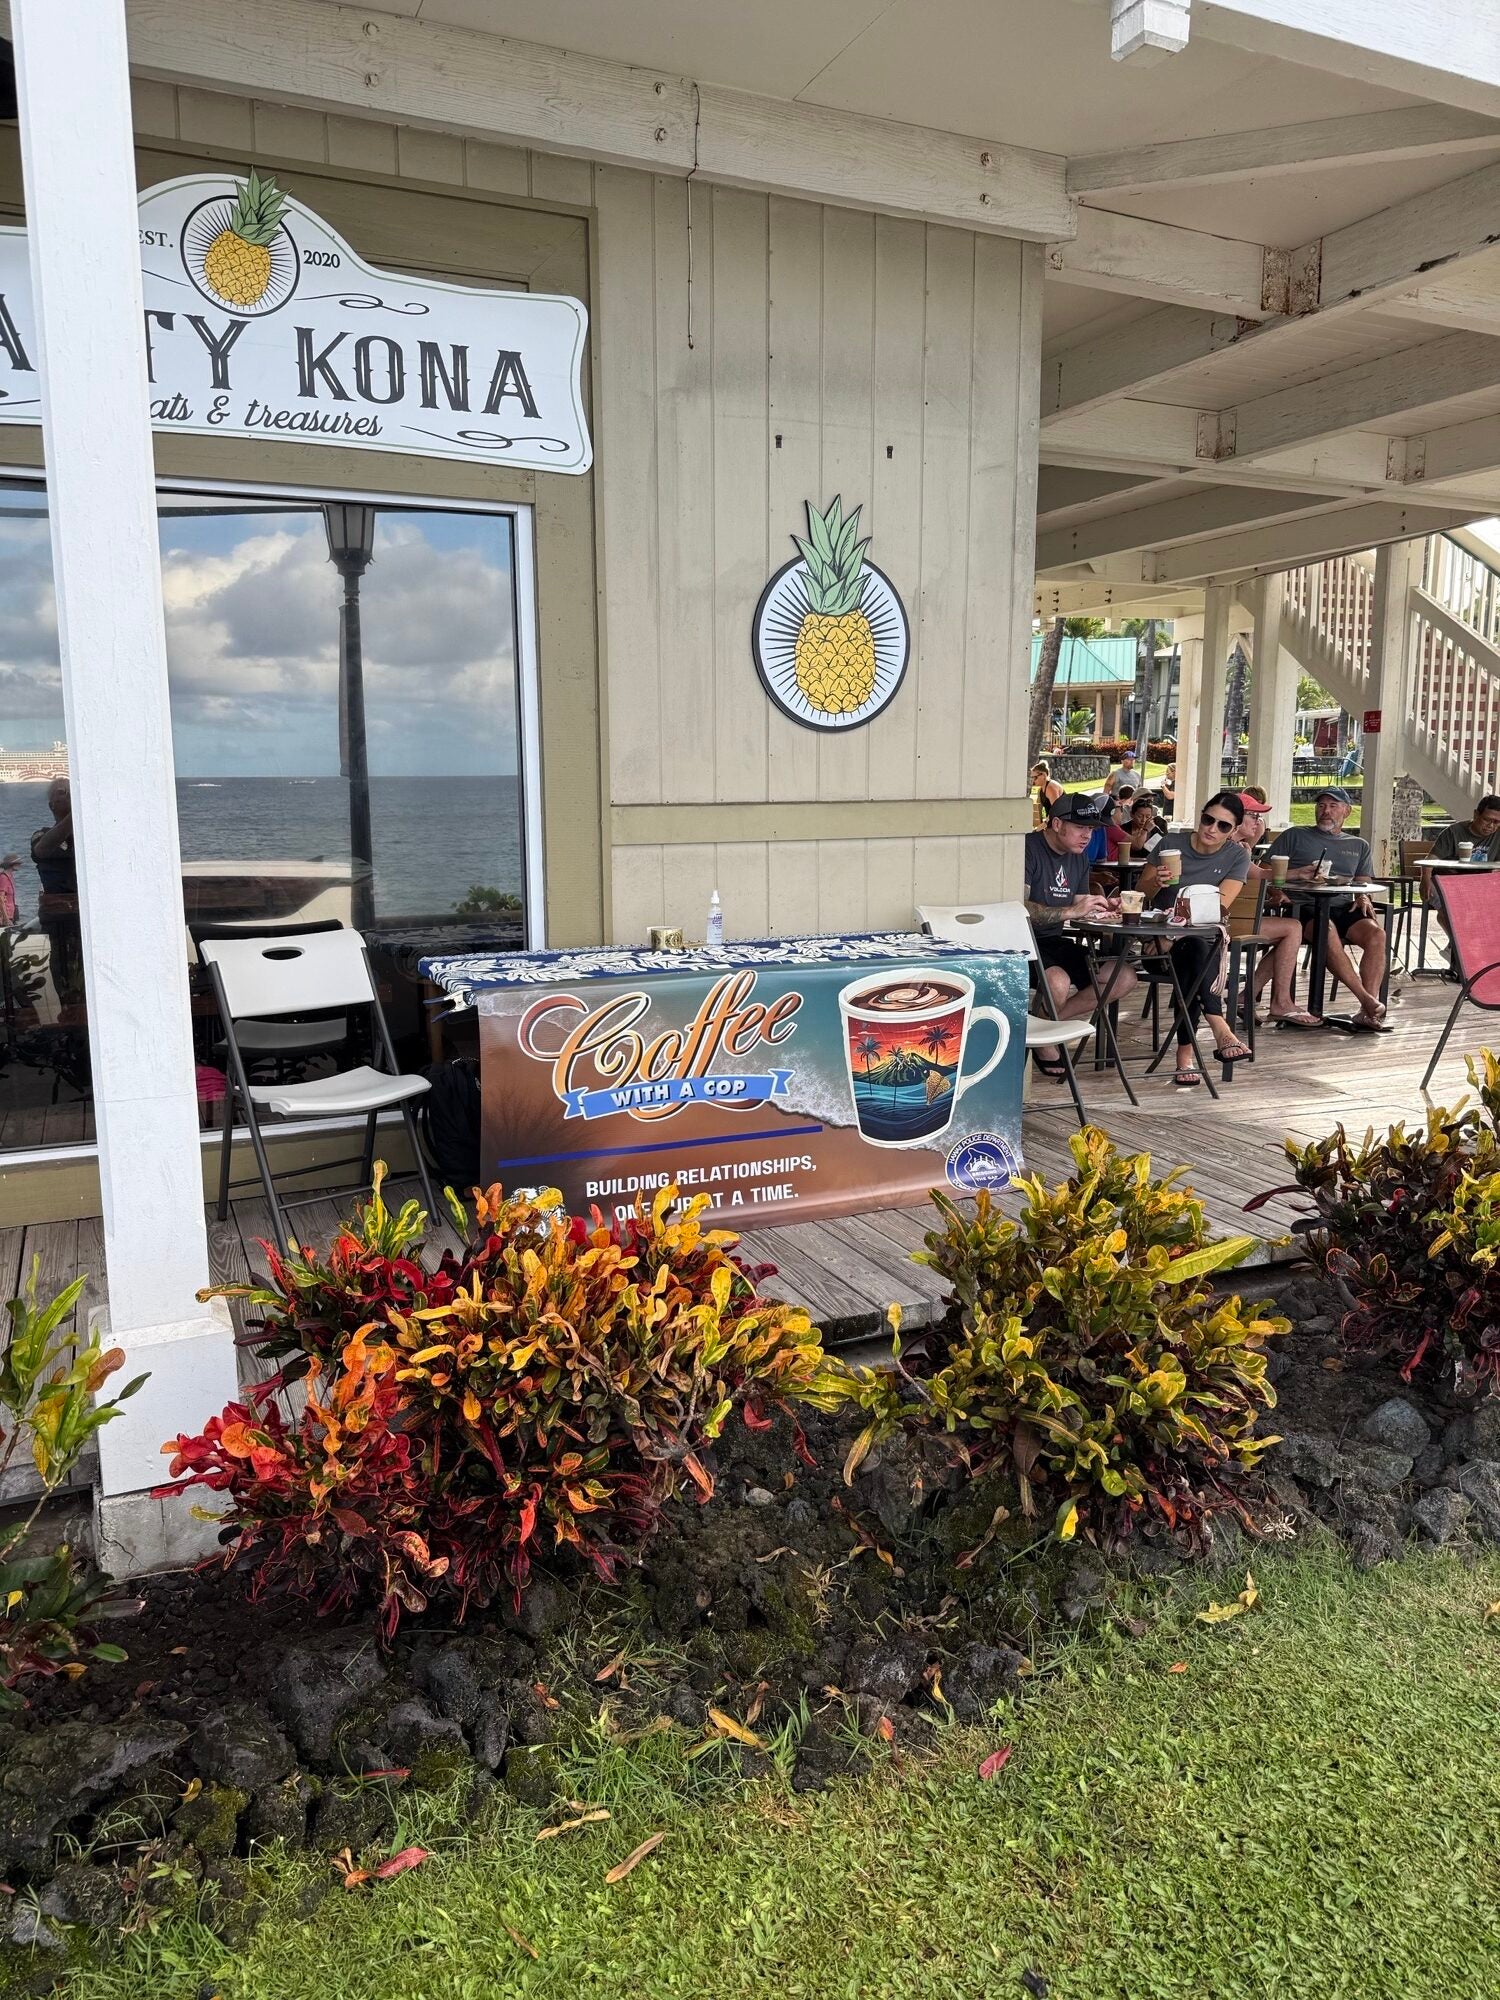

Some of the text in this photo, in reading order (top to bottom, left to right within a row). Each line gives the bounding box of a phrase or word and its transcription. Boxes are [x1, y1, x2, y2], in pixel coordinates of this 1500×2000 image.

[303, 250, 340, 268] 2020
[293, 326, 543, 419] KONA
[206, 395, 231, 425] &
[244, 399, 383, 437] treasures
[518, 969, 804, 1122] Coffee
[611, 1079, 747, 1108] WITH A COP
[962, 1134, 982, 1147] POLICE
[983, 1134, 1012, 1158] DEPARTMENT
[586, 1155, 817, 1198] BUILDING RELATIONSHIPS,
[615, 1202, 652, 1222] ONE
[732, 1190, 744, 1207] A
[750, 1183, 799, 1203] TIME.
